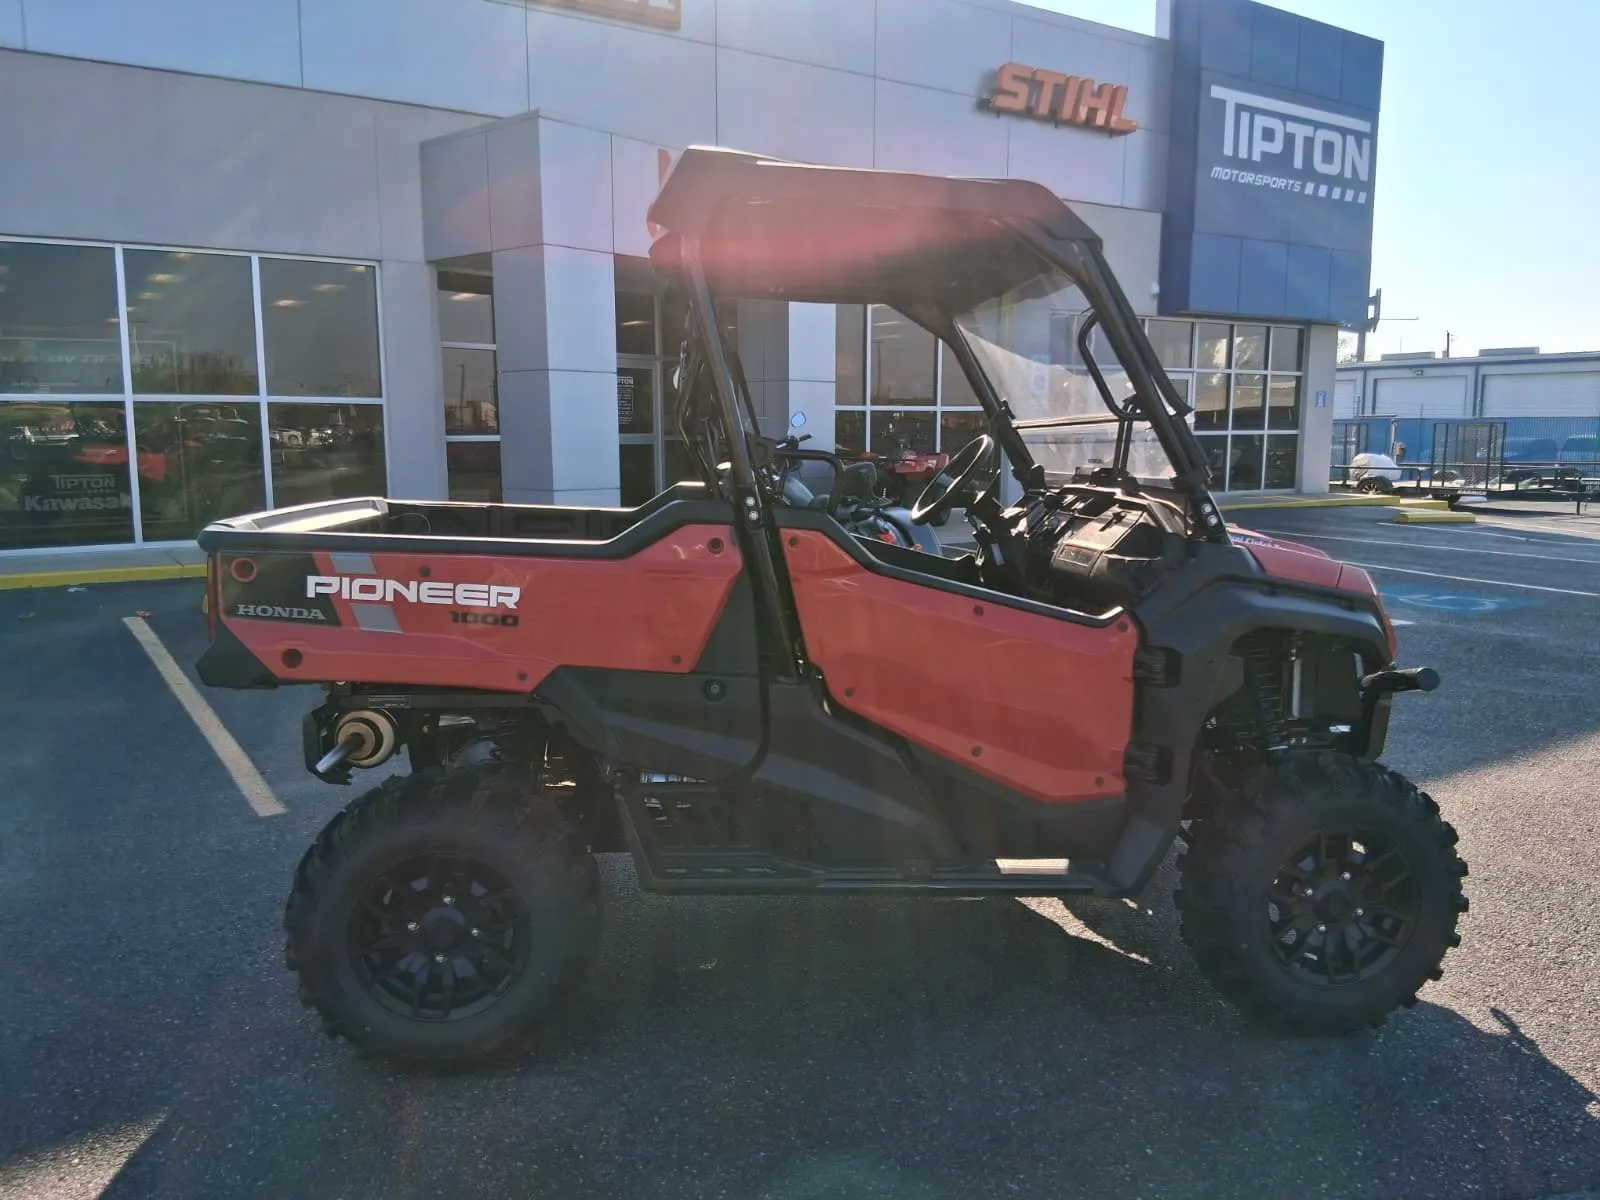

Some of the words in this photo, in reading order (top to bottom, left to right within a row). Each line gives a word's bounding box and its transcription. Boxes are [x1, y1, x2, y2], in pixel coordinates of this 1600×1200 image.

[993, 62, 1138, 135] STIHL
[1210, 84, 1372, 182] TIPTON
[1210, 166, 1303, 192] MOTORSPORTS
[48, 474, 117, 490] TIPTON
[25, 494, 132, 511] Kawasak
[306, 575, 521, 609] PIONEER
[235, 603, 327, 621] HONDA
[450, 611, 520, 627] 1000
